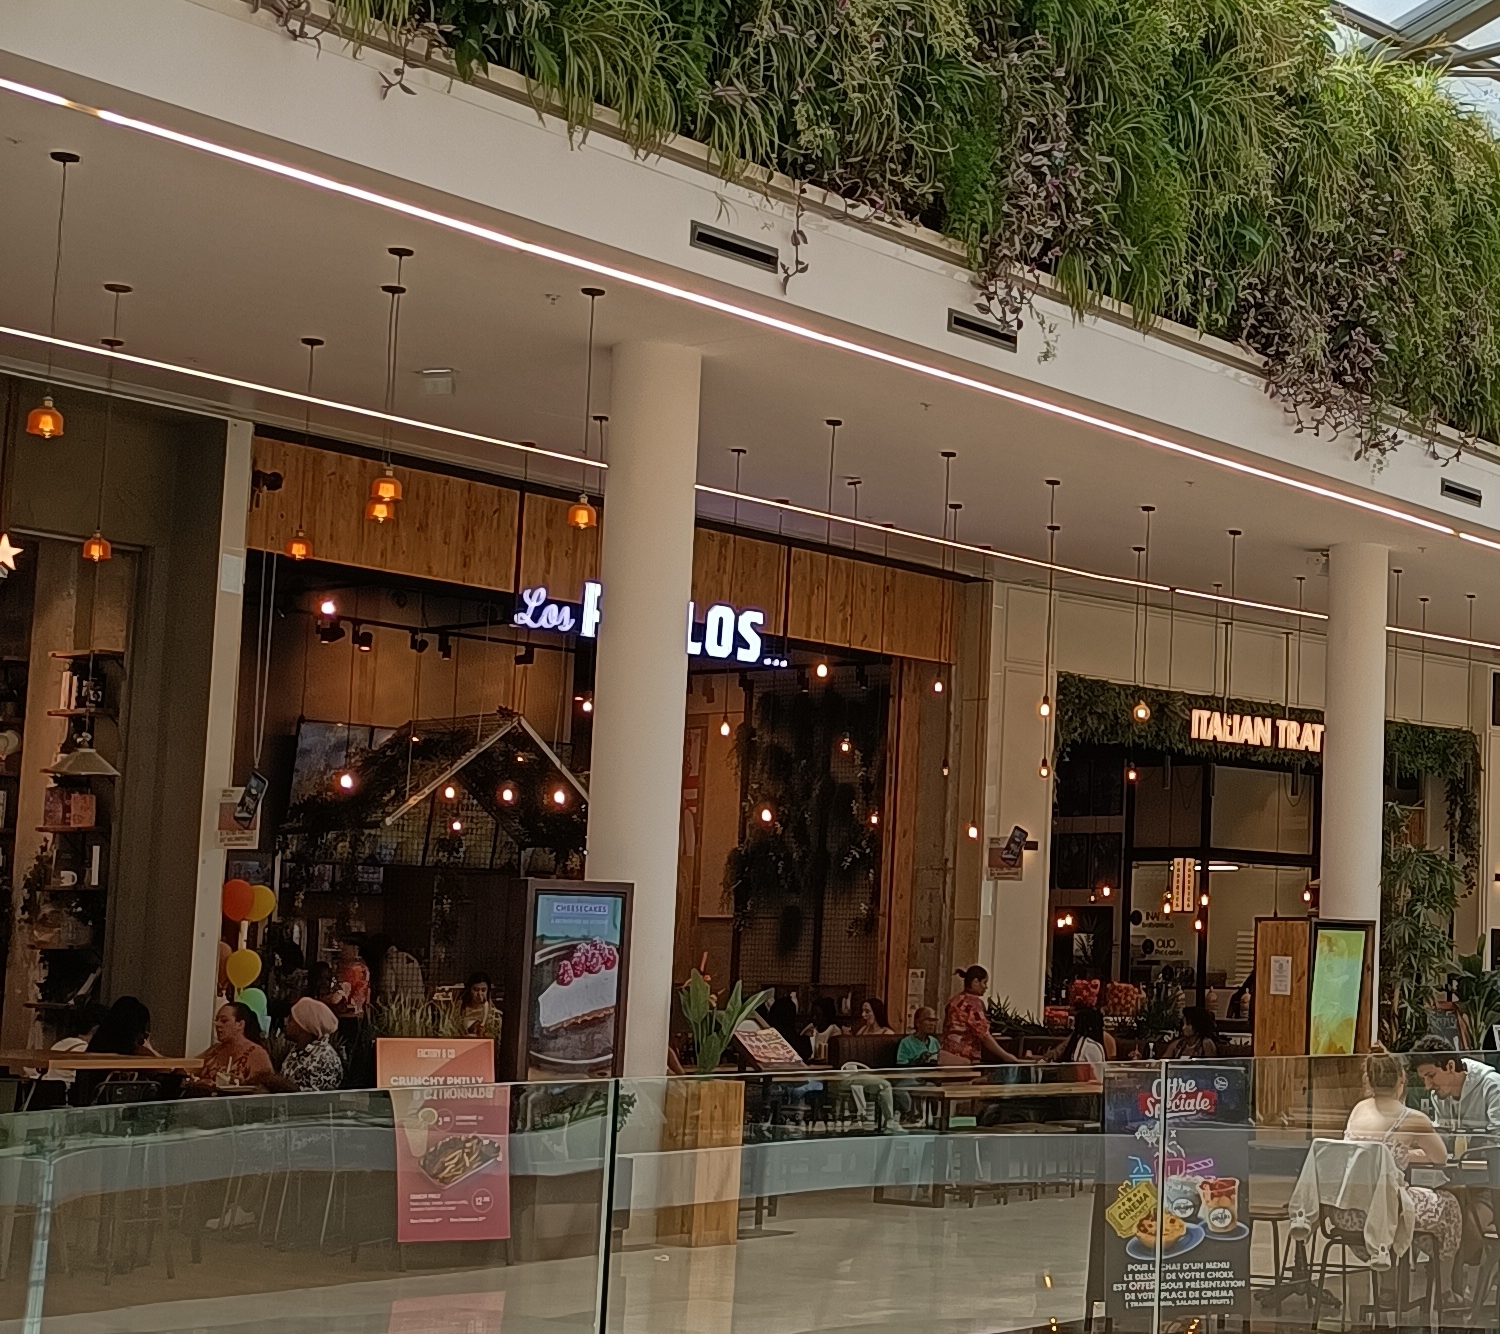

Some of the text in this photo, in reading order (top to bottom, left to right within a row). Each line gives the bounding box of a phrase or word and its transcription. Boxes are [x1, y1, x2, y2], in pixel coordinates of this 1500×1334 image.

[513, 586, 576, 633] Los
[1190, 708, 1272, 747] ITALIAN
[555, 904, 608, 914] CHEESECAKES
[389, 1075, 445, 1086] CRUNCHY
[1117, 1192, 1150, 1221] CINEMA
[1178, 1271, 1205, 1280] VOTRE
[1207, 1270, 1234, 1279] CHOIX
